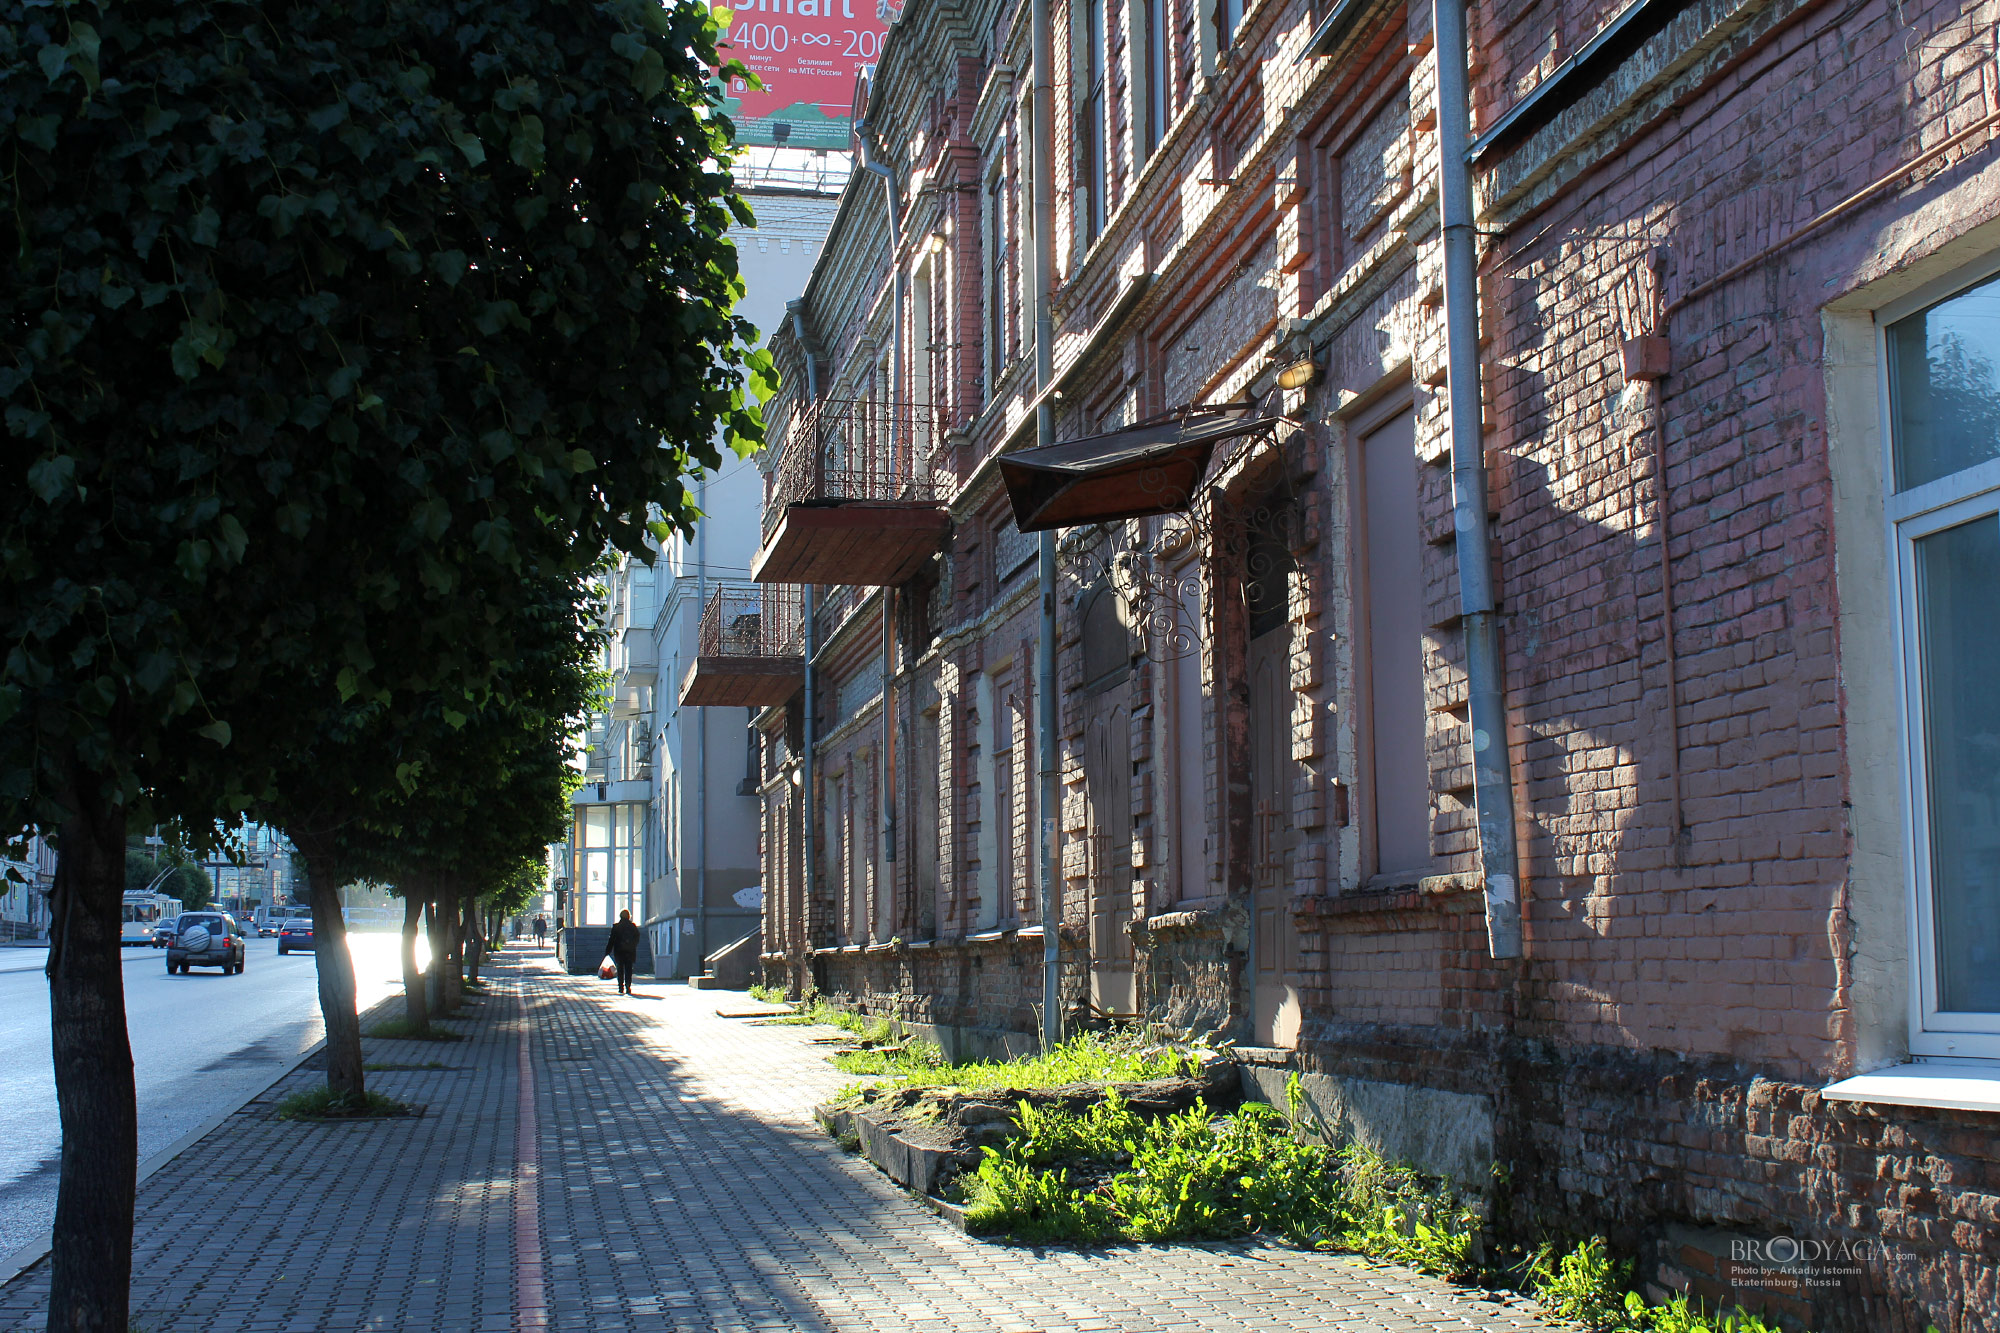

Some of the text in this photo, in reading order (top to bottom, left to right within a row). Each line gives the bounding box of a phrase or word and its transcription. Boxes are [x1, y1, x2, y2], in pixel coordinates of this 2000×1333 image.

[733, 22, 789, 53] 400
[749, 54, 772, 63] минут
[797, 57, 833, 67] безлимит
[799, 67, 815, 76] МТС
[816, 68, 842, 77] России
